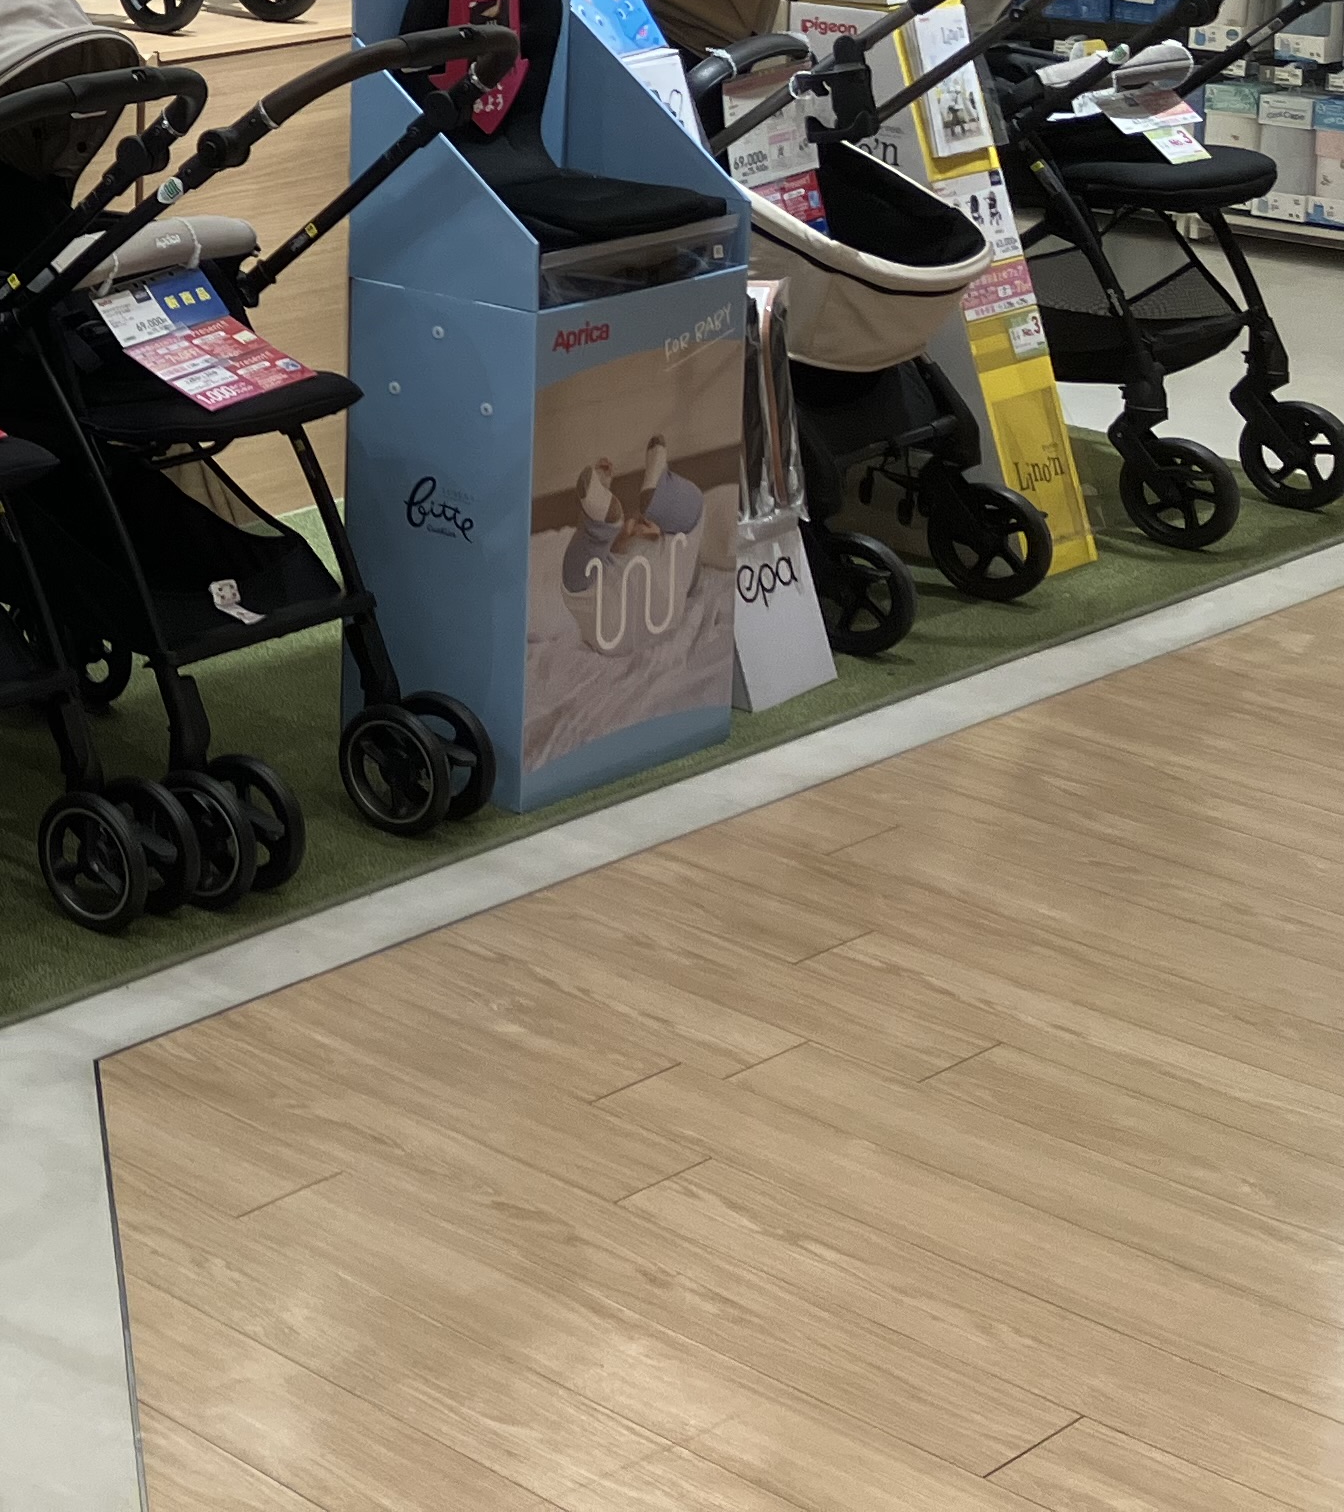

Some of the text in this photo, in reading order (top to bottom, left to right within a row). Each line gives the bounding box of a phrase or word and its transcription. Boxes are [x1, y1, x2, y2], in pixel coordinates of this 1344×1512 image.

[801, 17, 858, 36] pigeon
[552, 321, 611, 354] Aprica
[663, 302, 733, 360] FOR BABY
